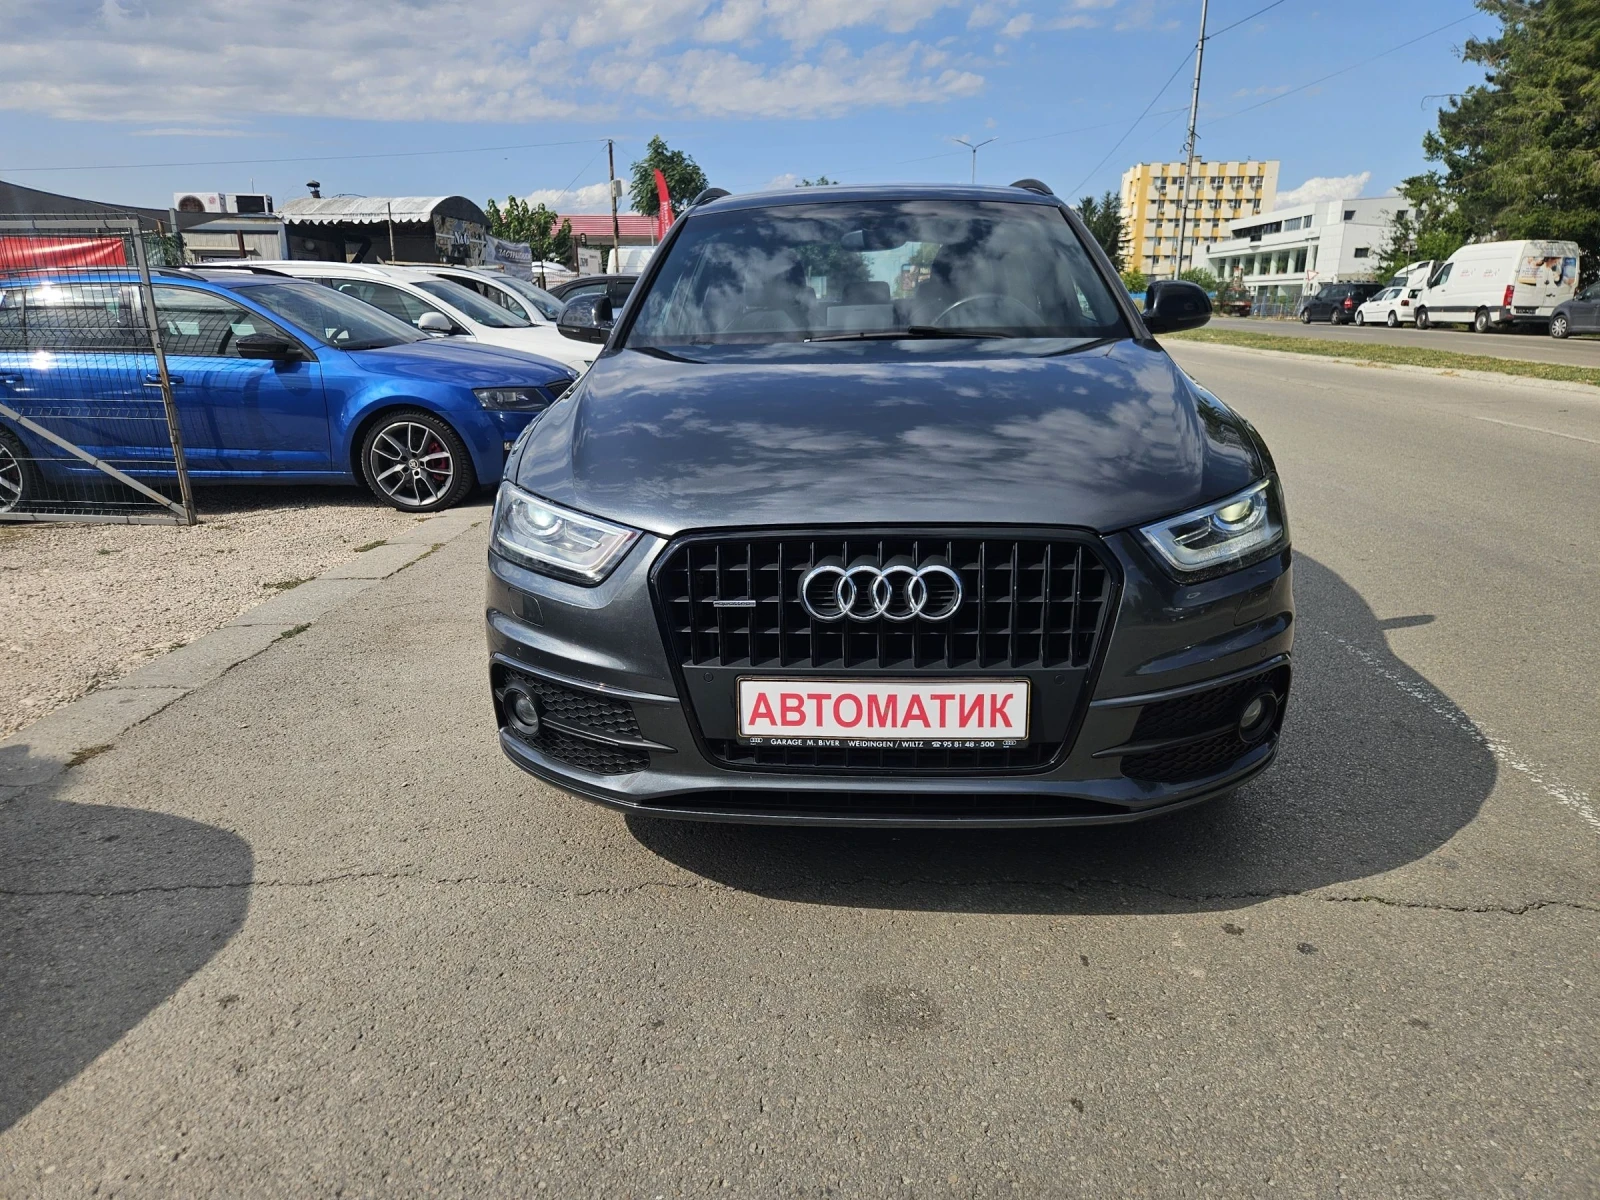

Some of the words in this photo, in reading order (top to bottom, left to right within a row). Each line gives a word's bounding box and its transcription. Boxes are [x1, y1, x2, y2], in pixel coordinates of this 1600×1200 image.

[748, 692, 1013, 728] АВТОМАТИК
[770, 738, 803, 746] GARAGE
[806, 739, 817, 747] M.
[847, 740, 894, 748] WEIDINGEN
[901, 740, 924, 748] WILTZ
